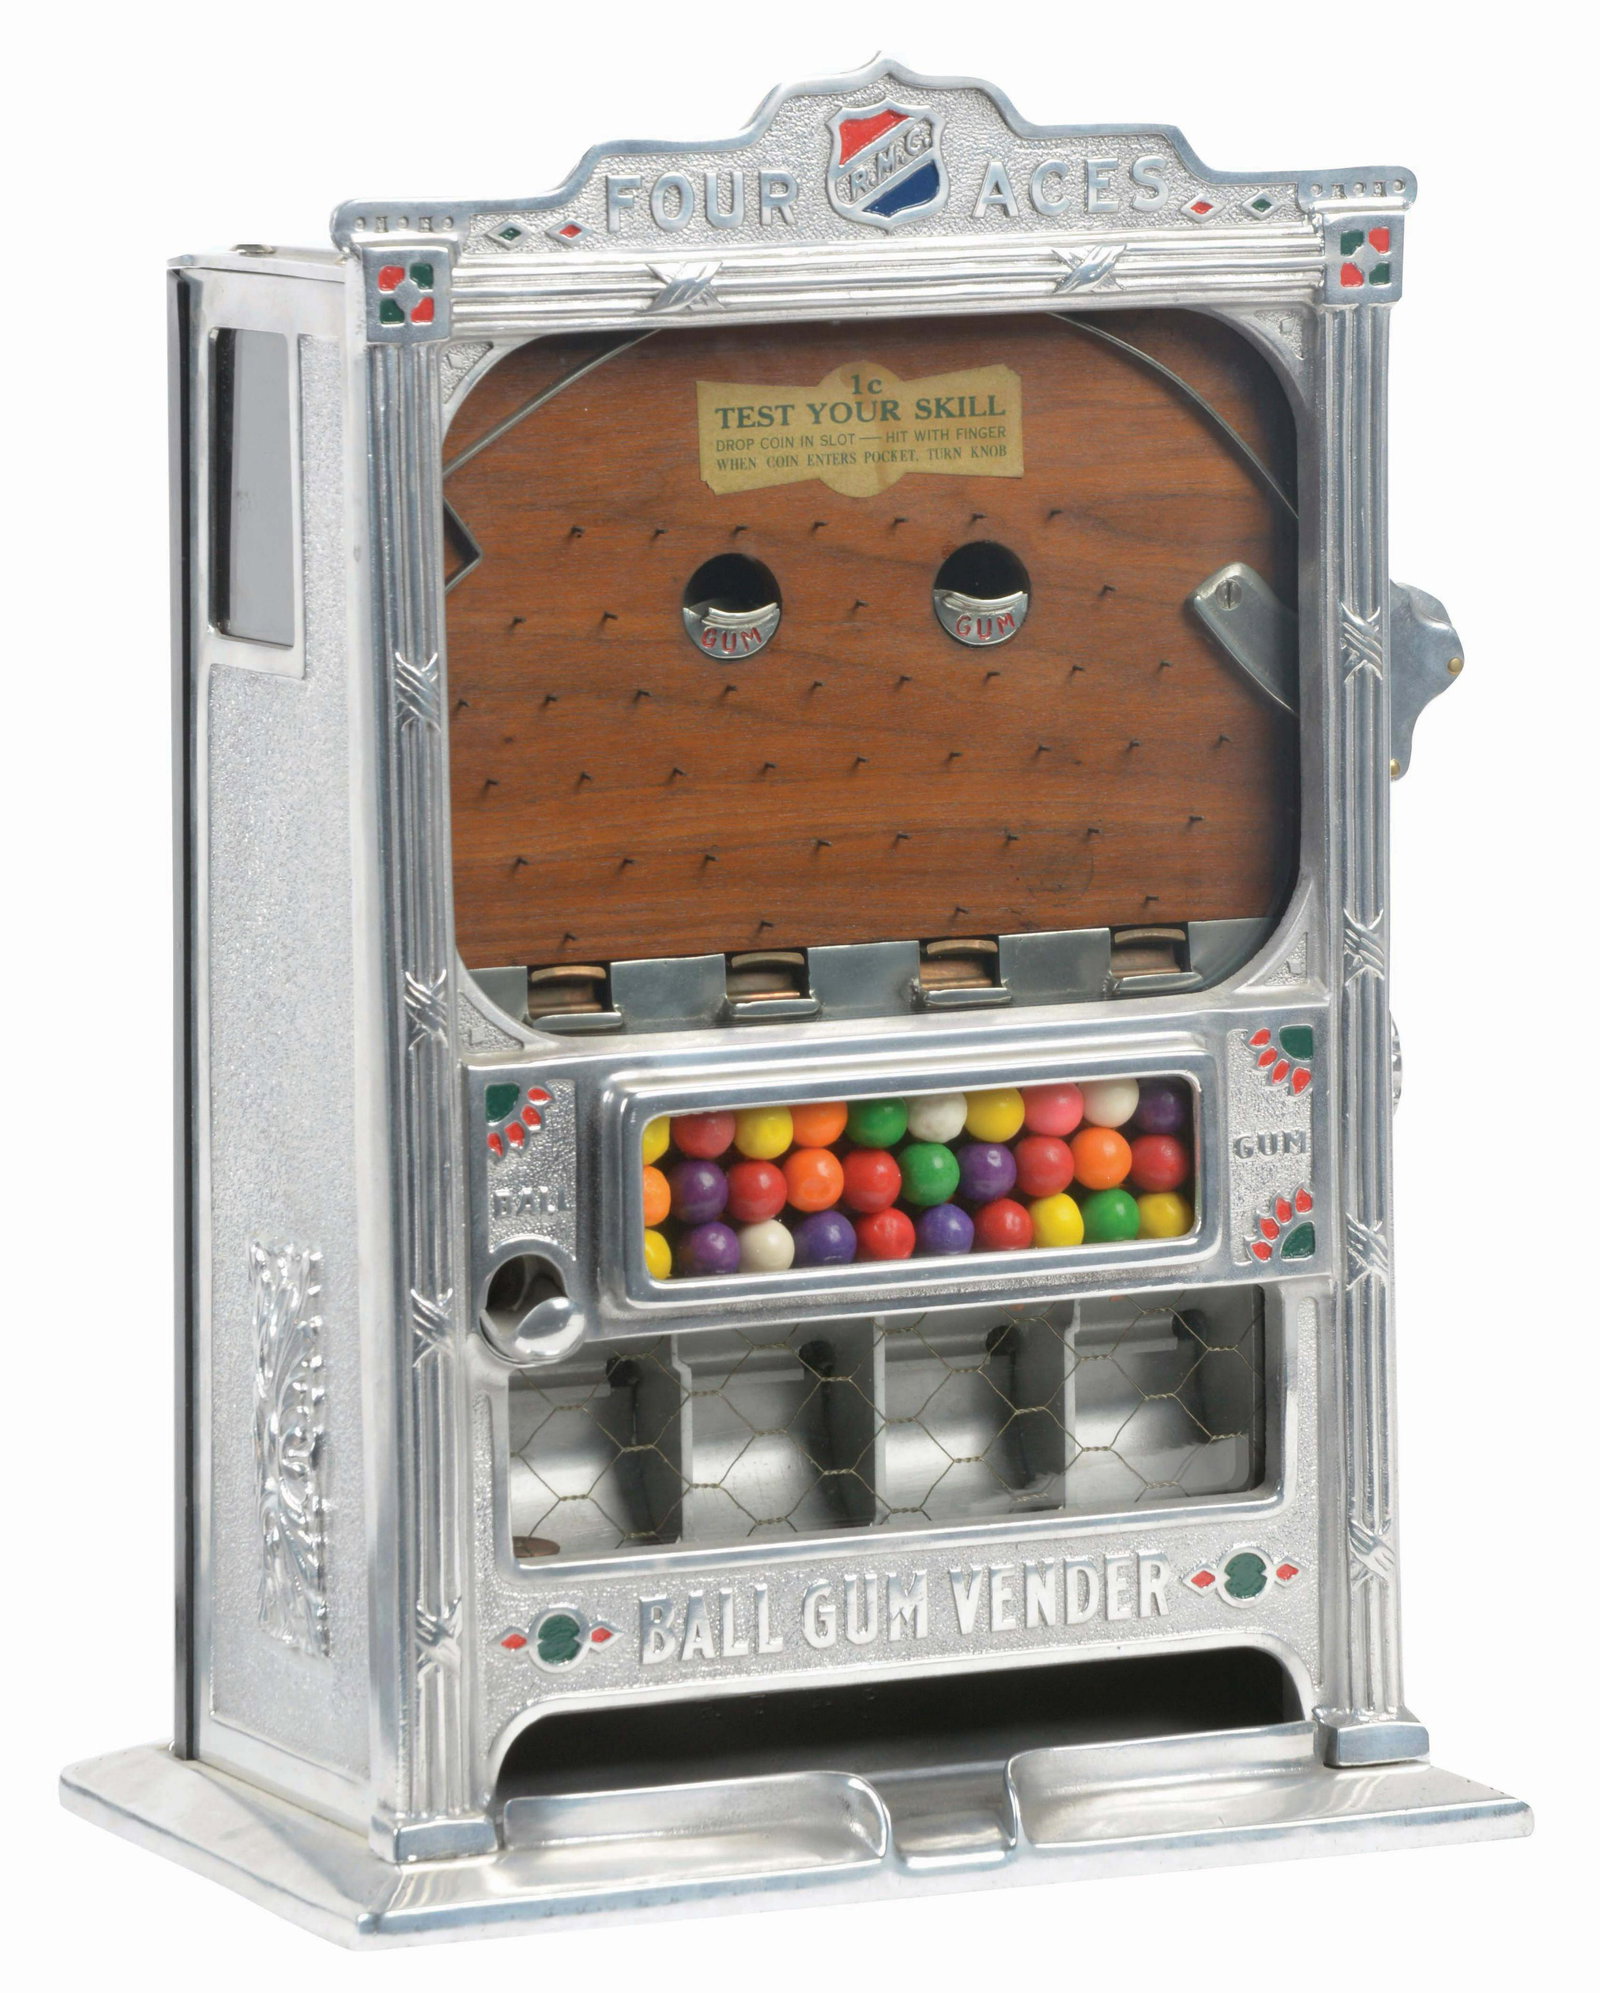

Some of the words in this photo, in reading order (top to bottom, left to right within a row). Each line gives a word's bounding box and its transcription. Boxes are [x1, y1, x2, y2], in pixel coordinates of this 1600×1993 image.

[605, 168, 798, 233] FOUR
[971, 157, 1171, 220] ACES
[851, 374, 883, 396] 1c
[715, 403, 795, 429] TEST
[806, 399, 901, 425] YOUR
[914, 394, 1006, 421] SKILL
[716, 438, 755, 452] DROP
[760, 437, 794, 450] COIN
[801, 435, 814, 447] IN
[820, 433, 855, 447] SLOT
[886, 430, 908, 443] HIT
[914, 428, 949, 442] WITH
[956, 426, 1007, 440] FINGER
[716, 457, 757, 471] WHEN
[766, 455, 799, 468] COIN
[807, 452, 857, 466] ENTERS
[927, 447, 962, 460] TURN
[971, 445, 1007, 458] KNOB
[701, 626, 763, 653] GUM
[955, 612, 1016, 641] GUM
[1233, 1128, 1308, 1159] GUM
[639, 1582, 784, 1666] BALL
[802, 1567, 929, 1650] GUM
[948, 1549, 1171, 1636] VENDER
